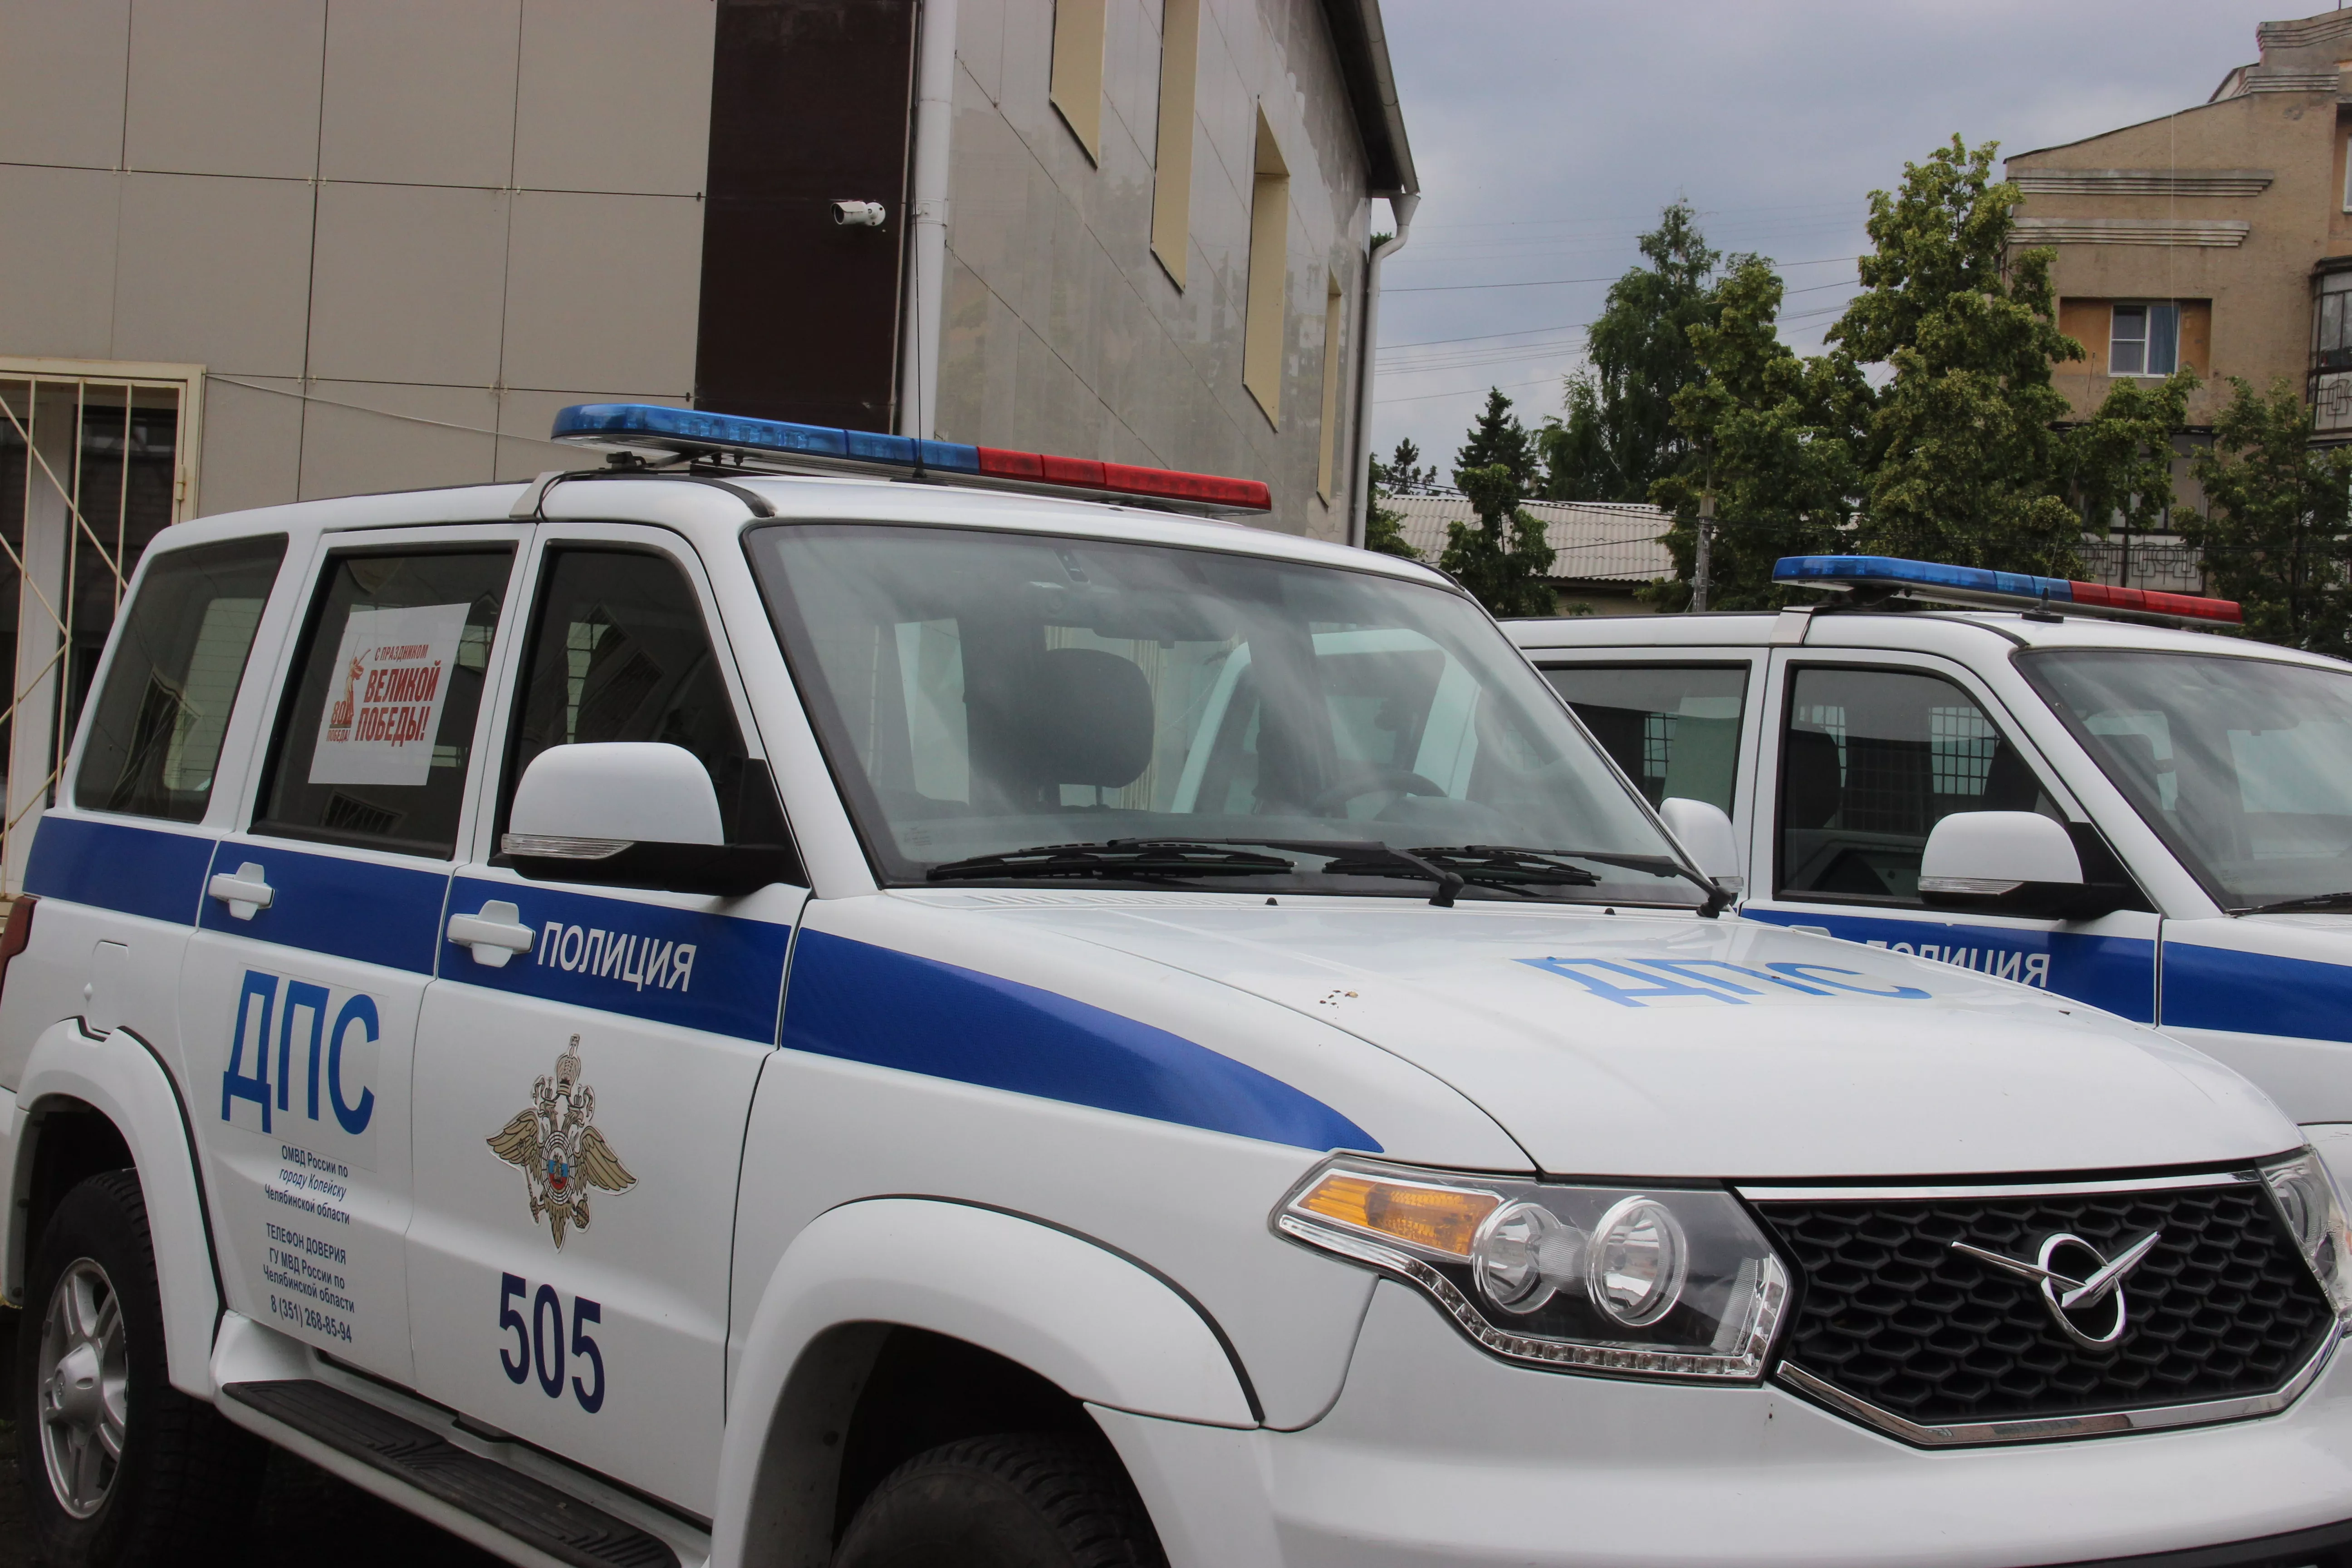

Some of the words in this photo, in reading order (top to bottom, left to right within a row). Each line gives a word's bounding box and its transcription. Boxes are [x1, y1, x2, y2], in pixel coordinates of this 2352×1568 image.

[375, 647, 381, 661] С
[380, 645, 429, 662] ПРАЗДНИКОМ
[364, 660, 441, 703] ВЕЛИКОЙ
[326, 729, 351, 744] ПОБЕДА!
[355, 706, 431, 747] ПОБЕДЫ!
[538, 921, 697, 992] ПОЛИЦИЯ
[1510, 957, 1932, 1007] ДПС
[221, 969, 379, 1135] ДПС
[282, 1145, 306, 1168] ОМВД
[308, 1152, 336, 1175] России
[338, 1165, 348, 1178] по
[265, 1184, 315, 1213] Челябинской
[317, 1203, 350, 1225] области
[279, 1168, 307, 1190] городу
[308, 1174, 347, 1202] Копейску
[266, 1223, 304, 1250] ТЕЛЕФОН
[306, 1238, 346, 1265] ДОВЕРИЯ
[263, 1264, 317, 1298] Челябинской
[319, 1288, 355, 1313] области
[270, 1247, 279, 1264] ГУ
[281, 1252, 300, 1275] МВД
[302, 1260, 332, 1284] России
[334, 1275, 345, 1289] по
[271, 1294, 277, 1313] 8
[279, 1298, 303, 1328] (351)
[305, 1307, 352, 1343] 268-85-94
[500, 1272, 605, 1414] 505
